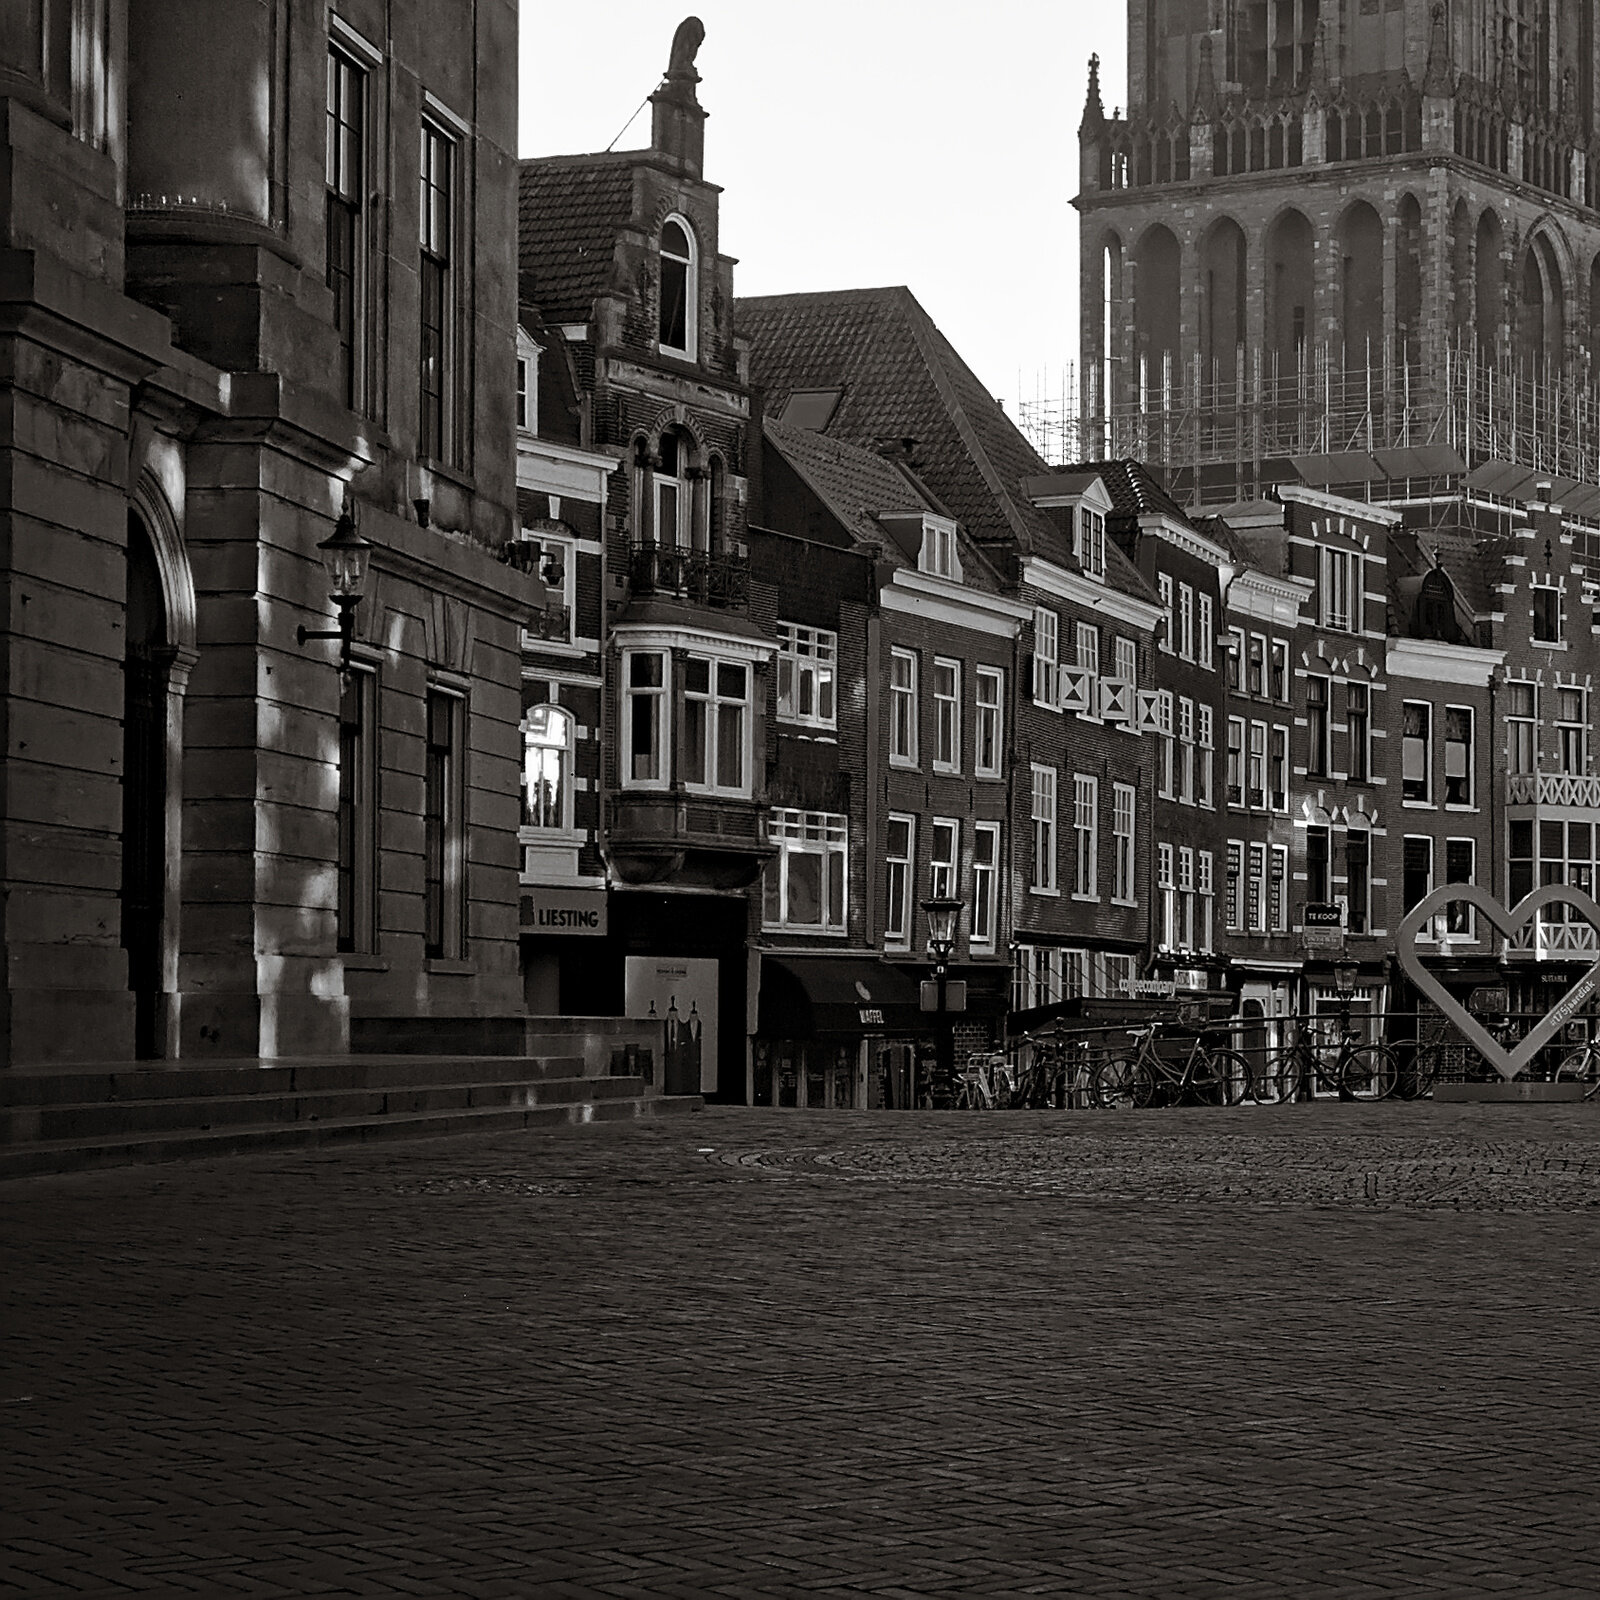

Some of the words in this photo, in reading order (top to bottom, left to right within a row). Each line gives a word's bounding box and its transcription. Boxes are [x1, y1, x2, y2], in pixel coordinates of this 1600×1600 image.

[539, 909, 599, 928] LIESTING
[1308, 912, 1317, 920] TE
[1317, 912, 1339, 921] KOOP
[859, 1009, 885, 1024] WAFFEL
